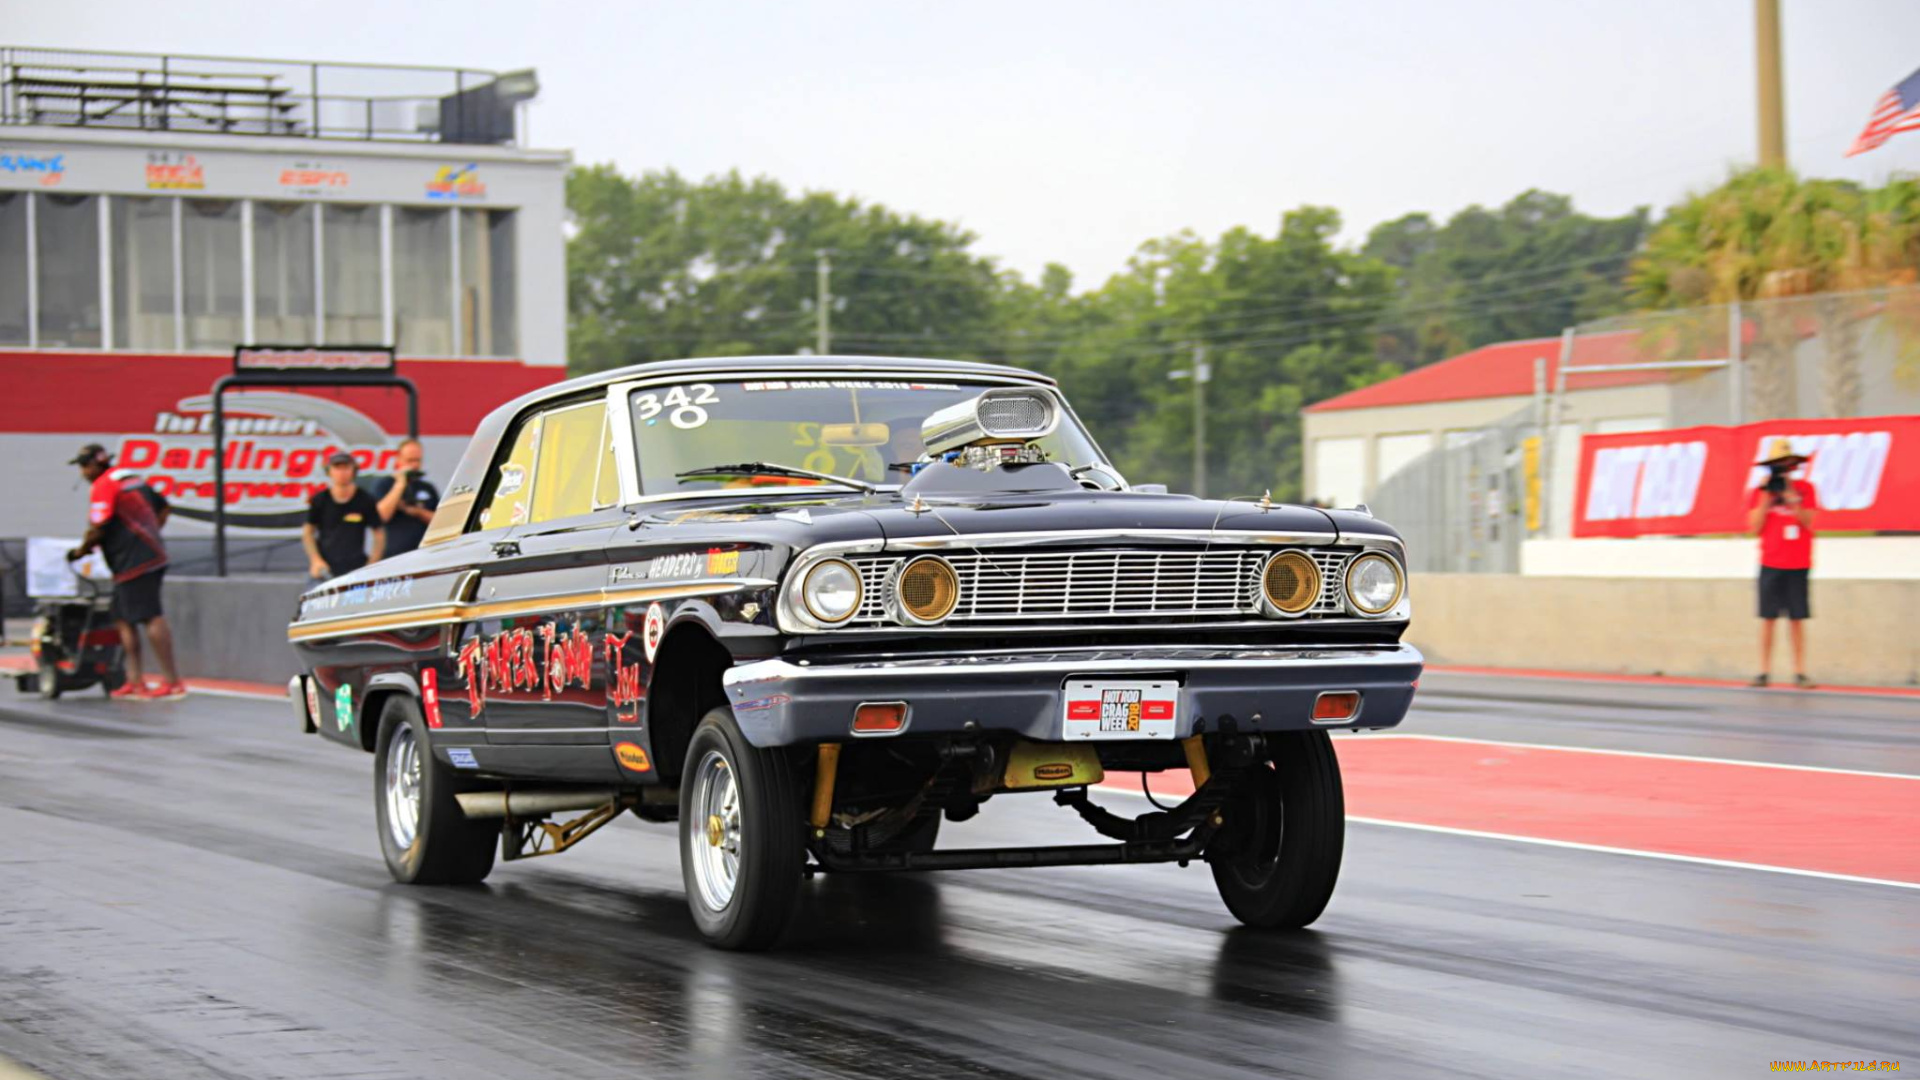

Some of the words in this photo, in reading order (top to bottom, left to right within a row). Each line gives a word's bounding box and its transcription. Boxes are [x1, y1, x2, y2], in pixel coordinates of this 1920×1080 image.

[790, 381, 831, 389] DRAG
[831, 381, 873, 389] WEEK
[634, 383, 720, 420] 342
[649, 552, 697, 579] HEADERS
[1103, 690, 1122, 703] HOT
[1121, 690, 1140, 703] ROD
[1101, 717, 1128, 731] WEEK
[1128, 703, 1140, 730] 2018
